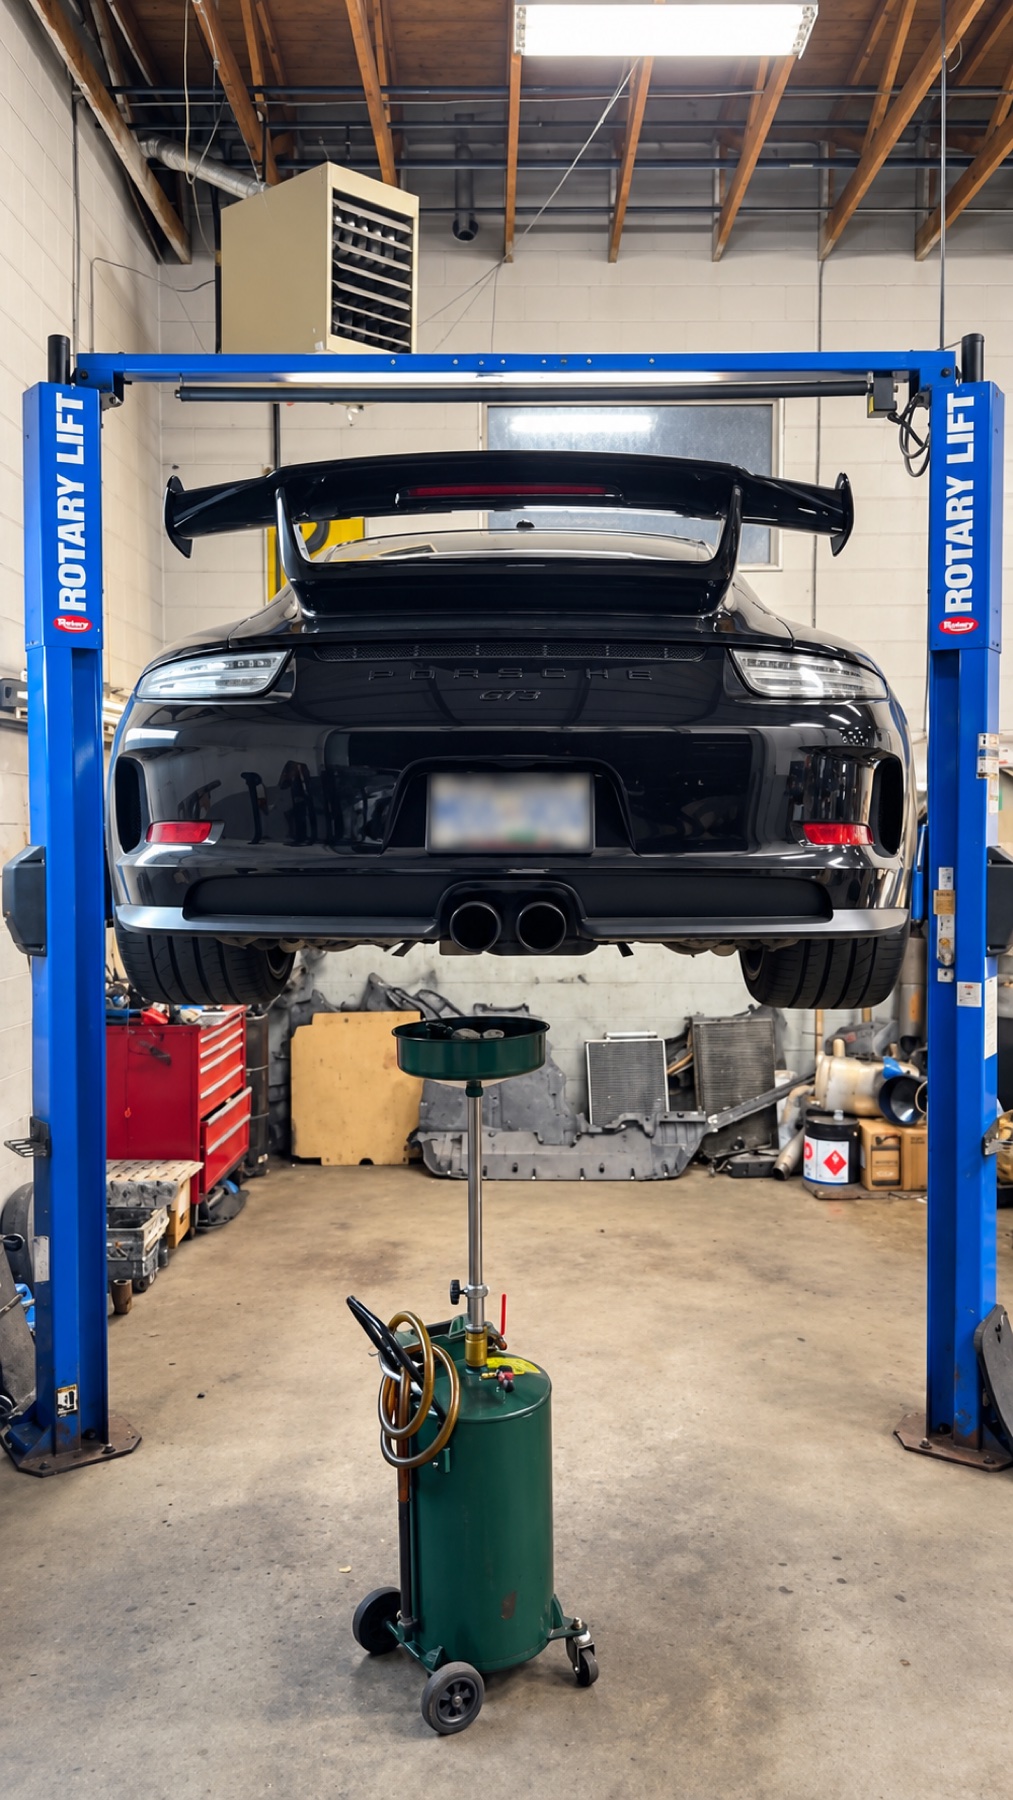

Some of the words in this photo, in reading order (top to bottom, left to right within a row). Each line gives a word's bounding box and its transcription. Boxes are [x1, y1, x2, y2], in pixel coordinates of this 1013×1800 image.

[55, 392, 84, 465] LIFT
[946, 392, 975, 464] LIFT
[56, 473, 86, 612] ROTARY
[944, 476, 974, 614] ROTARY
[57, 617, 89, 631] Rotary
[943, 620, 975, 632] Rotary
[368, 667, 653, 681] PORSCHE
[479, 689, 542, 701] GT3
